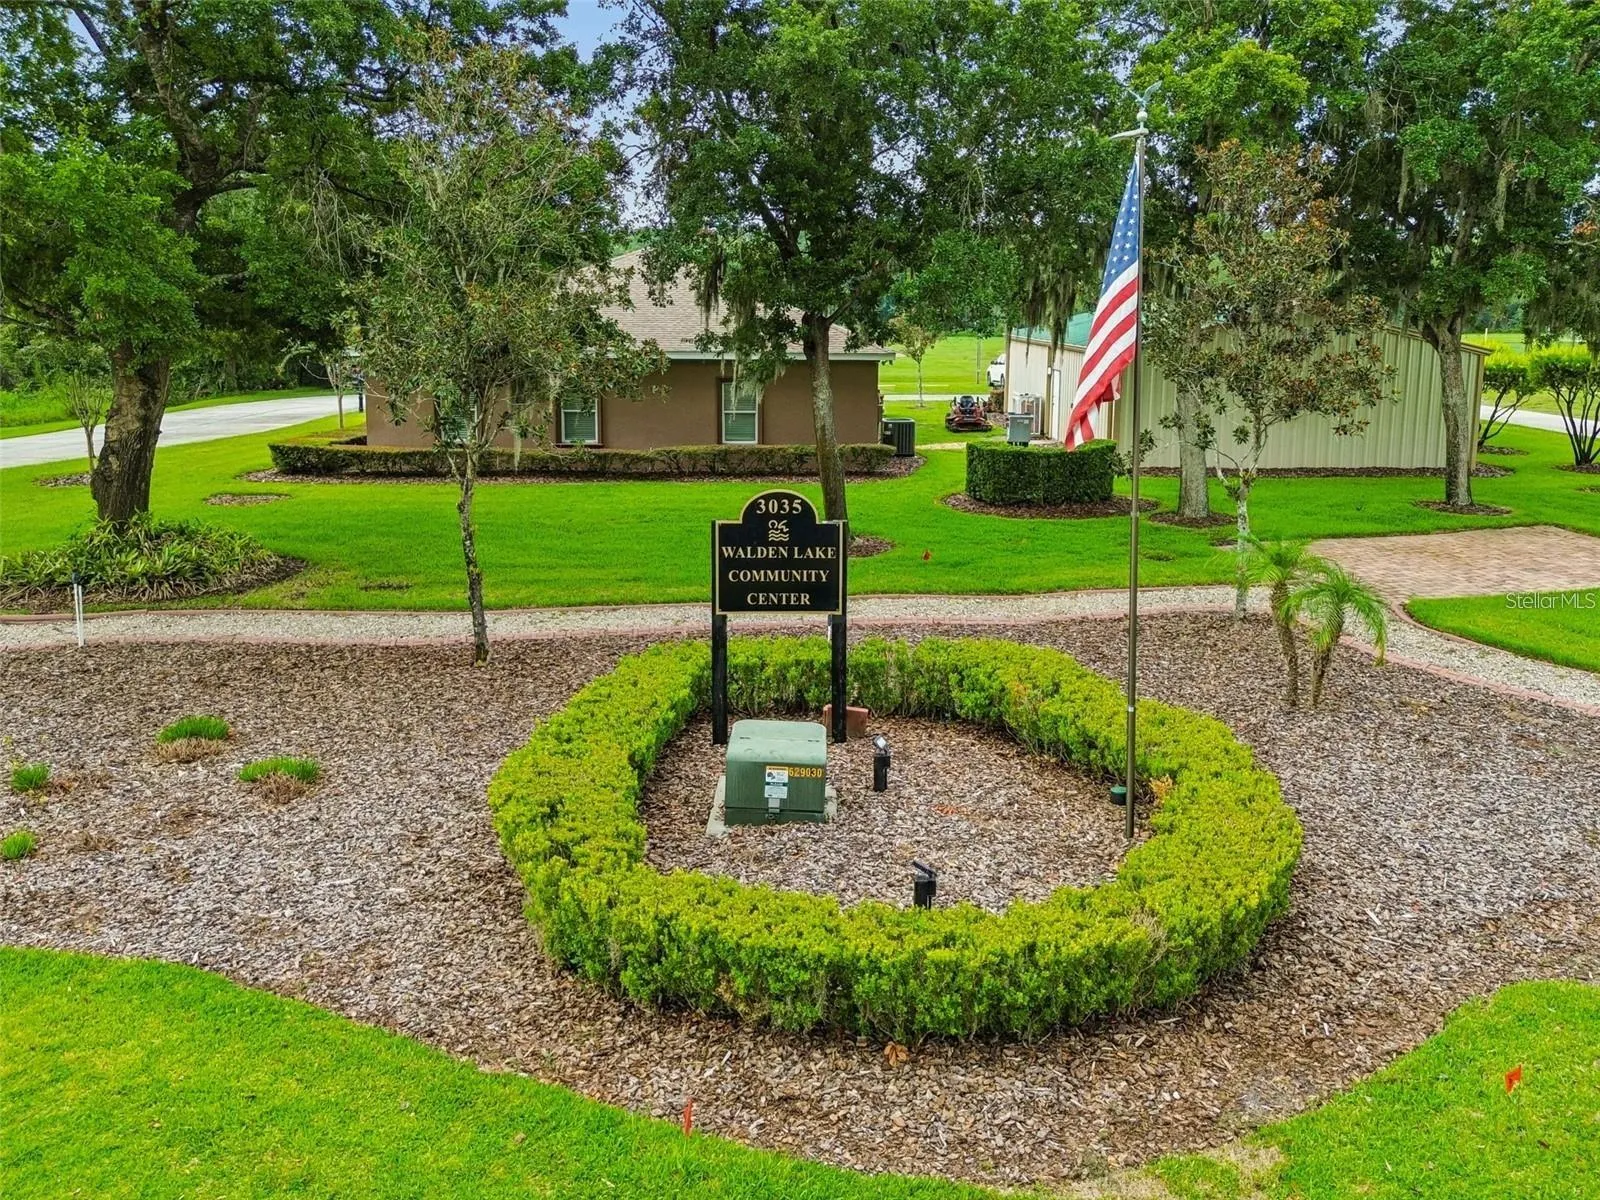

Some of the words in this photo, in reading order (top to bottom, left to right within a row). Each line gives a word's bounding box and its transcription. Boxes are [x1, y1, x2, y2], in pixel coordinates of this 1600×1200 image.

[756, 499, 802, 514] 3035
[721, 546, 788, 559] WALDEN
[793, 546, 837, 559] LAKE
[728, 569, 830, 582] COMMUNITY
[746, 592, 810, 605] CENTER
